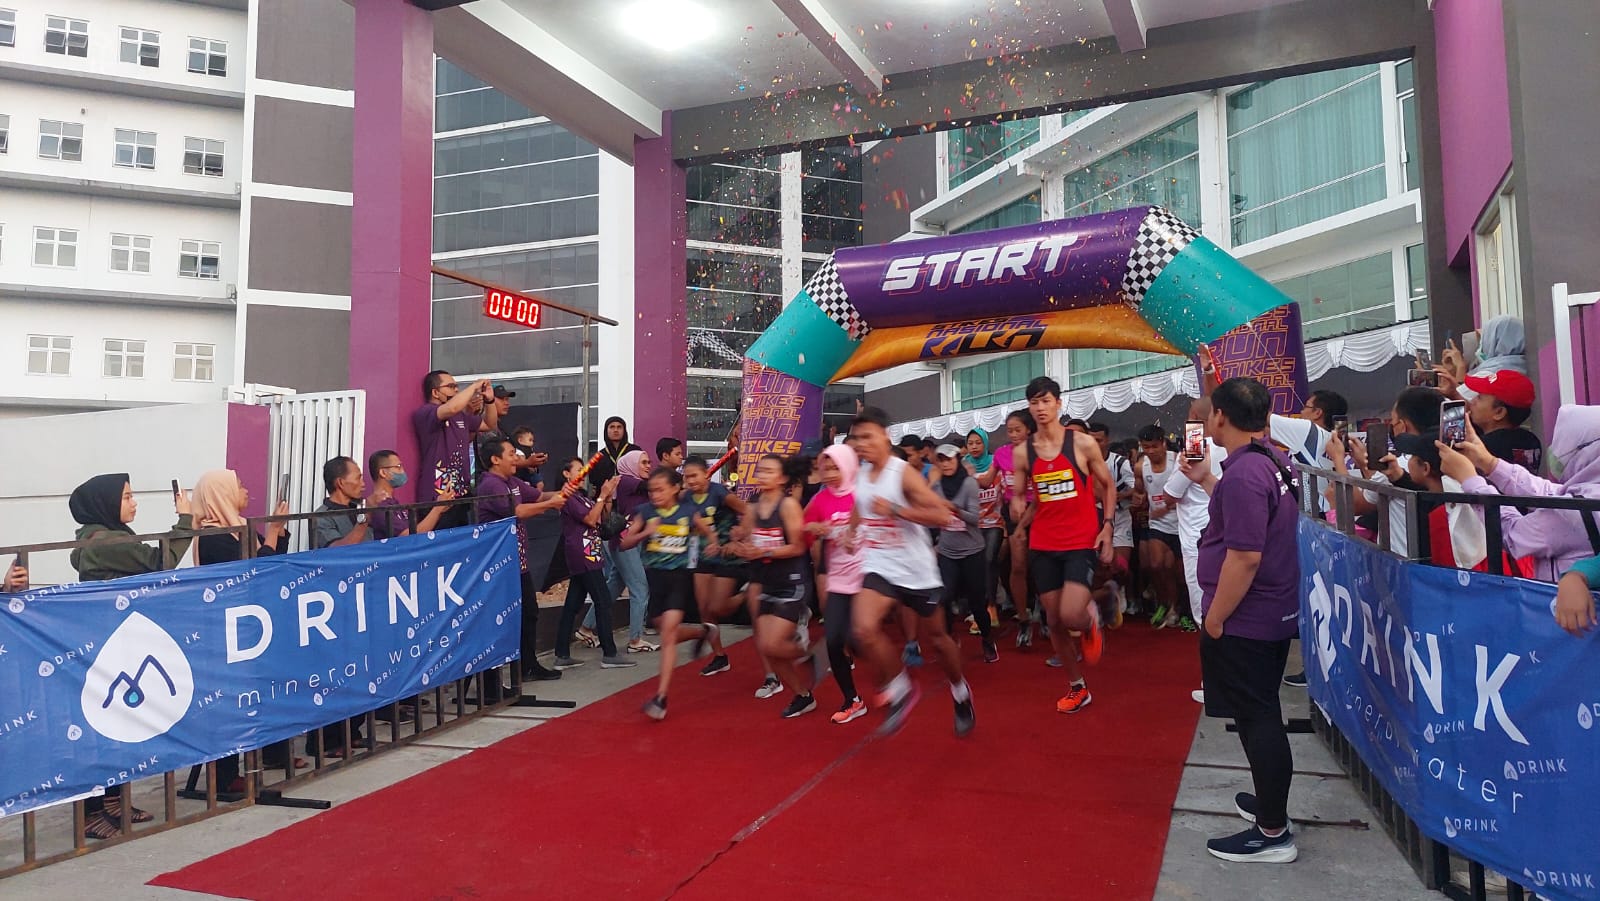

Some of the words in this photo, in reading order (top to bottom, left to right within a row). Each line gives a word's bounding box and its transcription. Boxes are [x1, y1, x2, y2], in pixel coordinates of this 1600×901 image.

[882, 234, 1080, 292] START
[926, 320, 1049, 338] NASIONAL
[1217, 357, 1295, 379] TIKES
[489, 554, 513, 574] DRINK
[215, 567, 259, 593] DRINK
[289, 566, 325, 590] DRINK
[225, 562, 464, 664] DRINK
[414, 611, 435, 630] DRIN
[458, 599, 484, 622] DRINK
[54, 641, 94, 665] DRIN
[429, 653, 453, 676] DRINK
[472, 644, 496, 665] DRINK
[1334, 583, 1530, 745] DRINK
[238, 655, 368, 709] mineral
[389, 629, 464, 665] water
[198, 688, 224, 708] INK
[0, 709, 38, 736] INK
[1434, 719, 1465, 735] DRIN
[106, 755, 159, 787] DRINK
[1517, 758, 1568, 774] DRINK
[5, 773, 65, 808] DRINK
[1454, 818, 1499, 832] DRINK
[1536, 870, 1595, 889] DRINK
